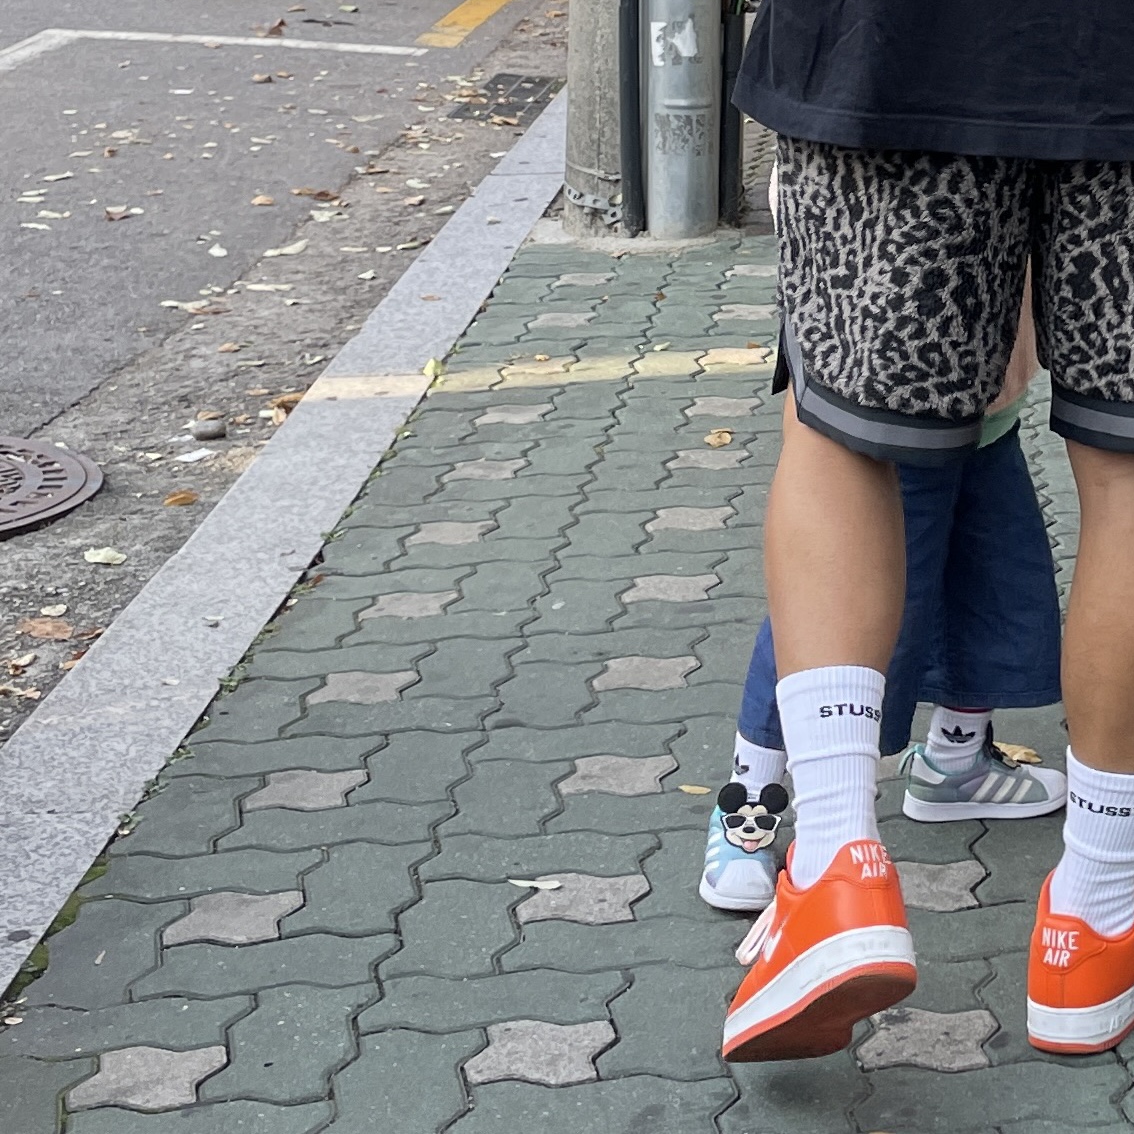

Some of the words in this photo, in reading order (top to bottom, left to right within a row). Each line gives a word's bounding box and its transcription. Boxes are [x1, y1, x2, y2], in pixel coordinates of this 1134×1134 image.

[849, 843, 892, 865] NIKE
[860, 861, 888, 881] AIR
[1041, 926, 1080, 951] NIKE
[1043, 948, 1072, 968] AIR
